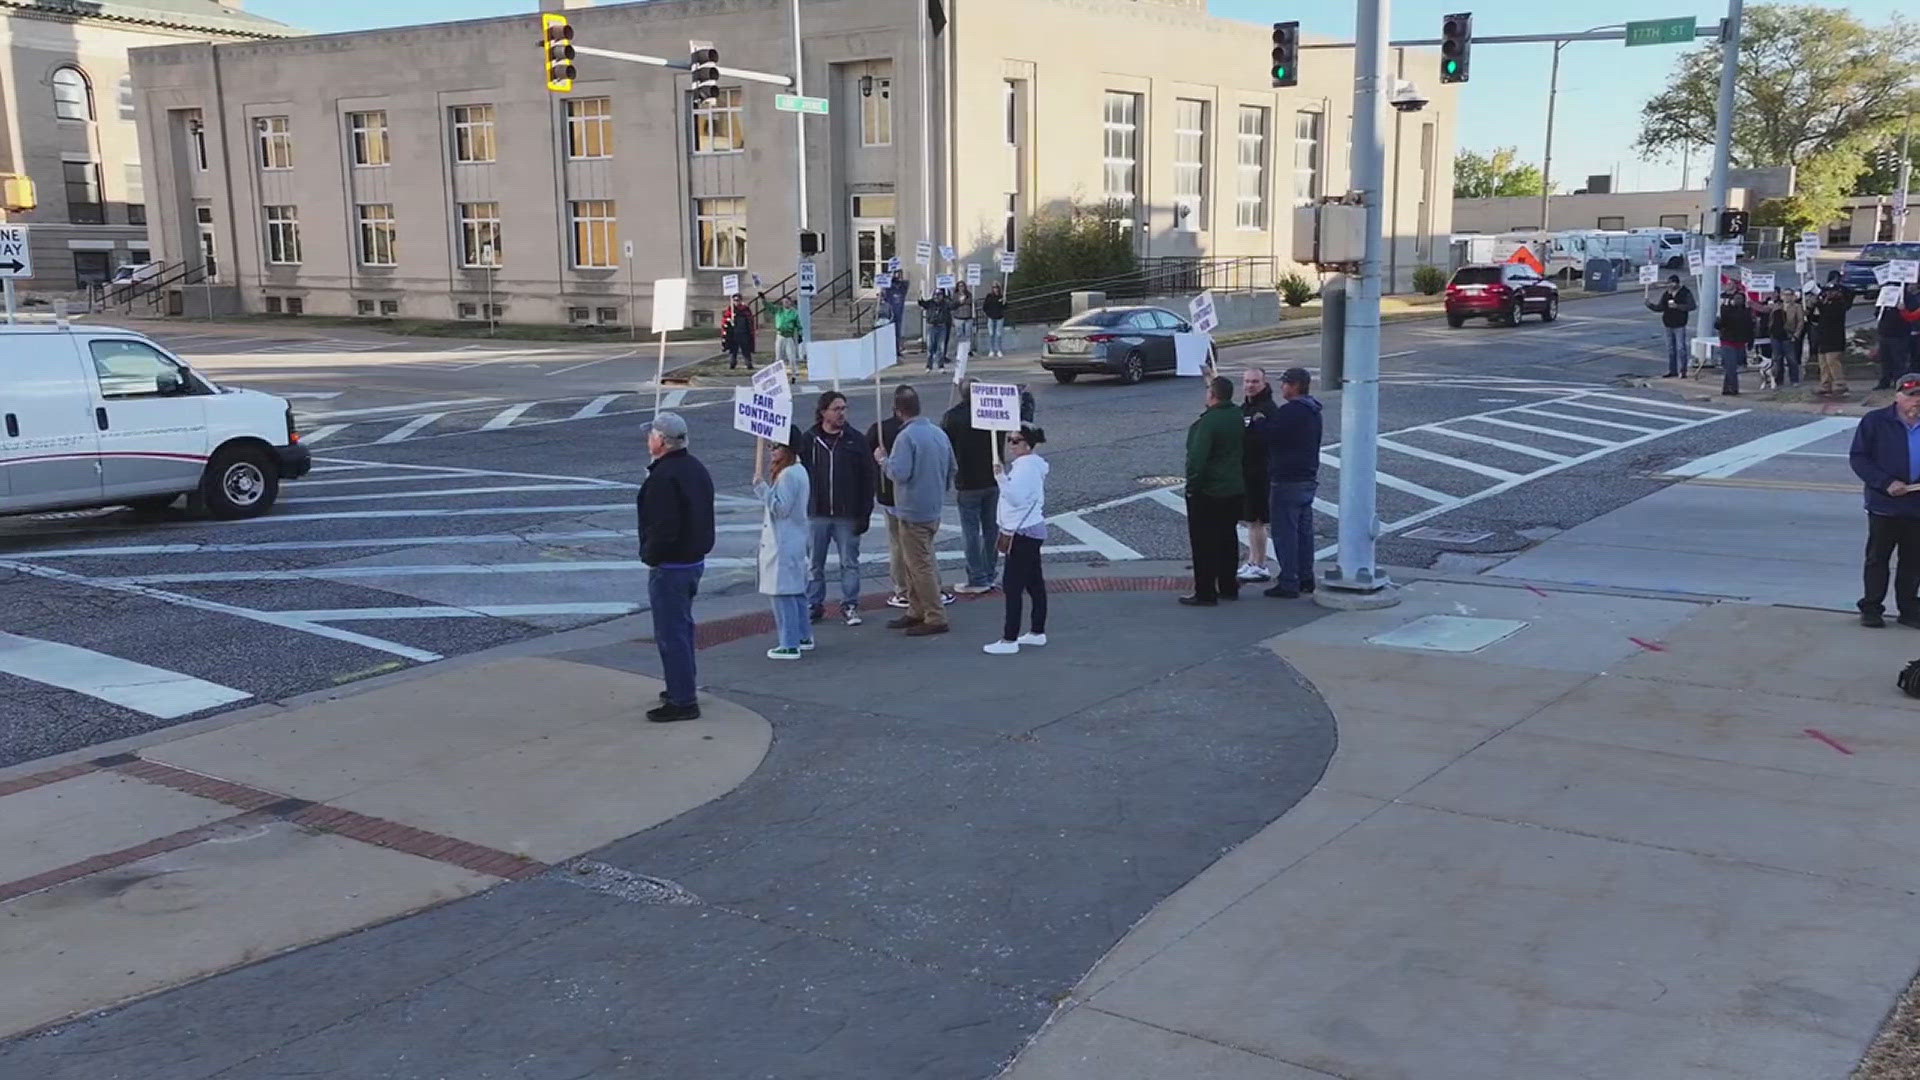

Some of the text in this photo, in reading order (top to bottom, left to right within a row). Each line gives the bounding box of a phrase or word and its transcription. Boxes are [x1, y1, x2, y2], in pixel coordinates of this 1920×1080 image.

[1633, 25, 1684, 39] 17TH ST
[0, 230, 20, 241] NE
[0, 244, 22, 256] AY
[802, 265, 814, 273] ONE
[1000, 386, 1016, 396] OUR
[753, 393, 774, 409] FAIR
[980, 398, 1003, 408] LETTER
[738, 403, 787, 427] CONTRACT
[977, 409, 1010, 420] CARRIERS
[750, 420, 774, 437] NOW
